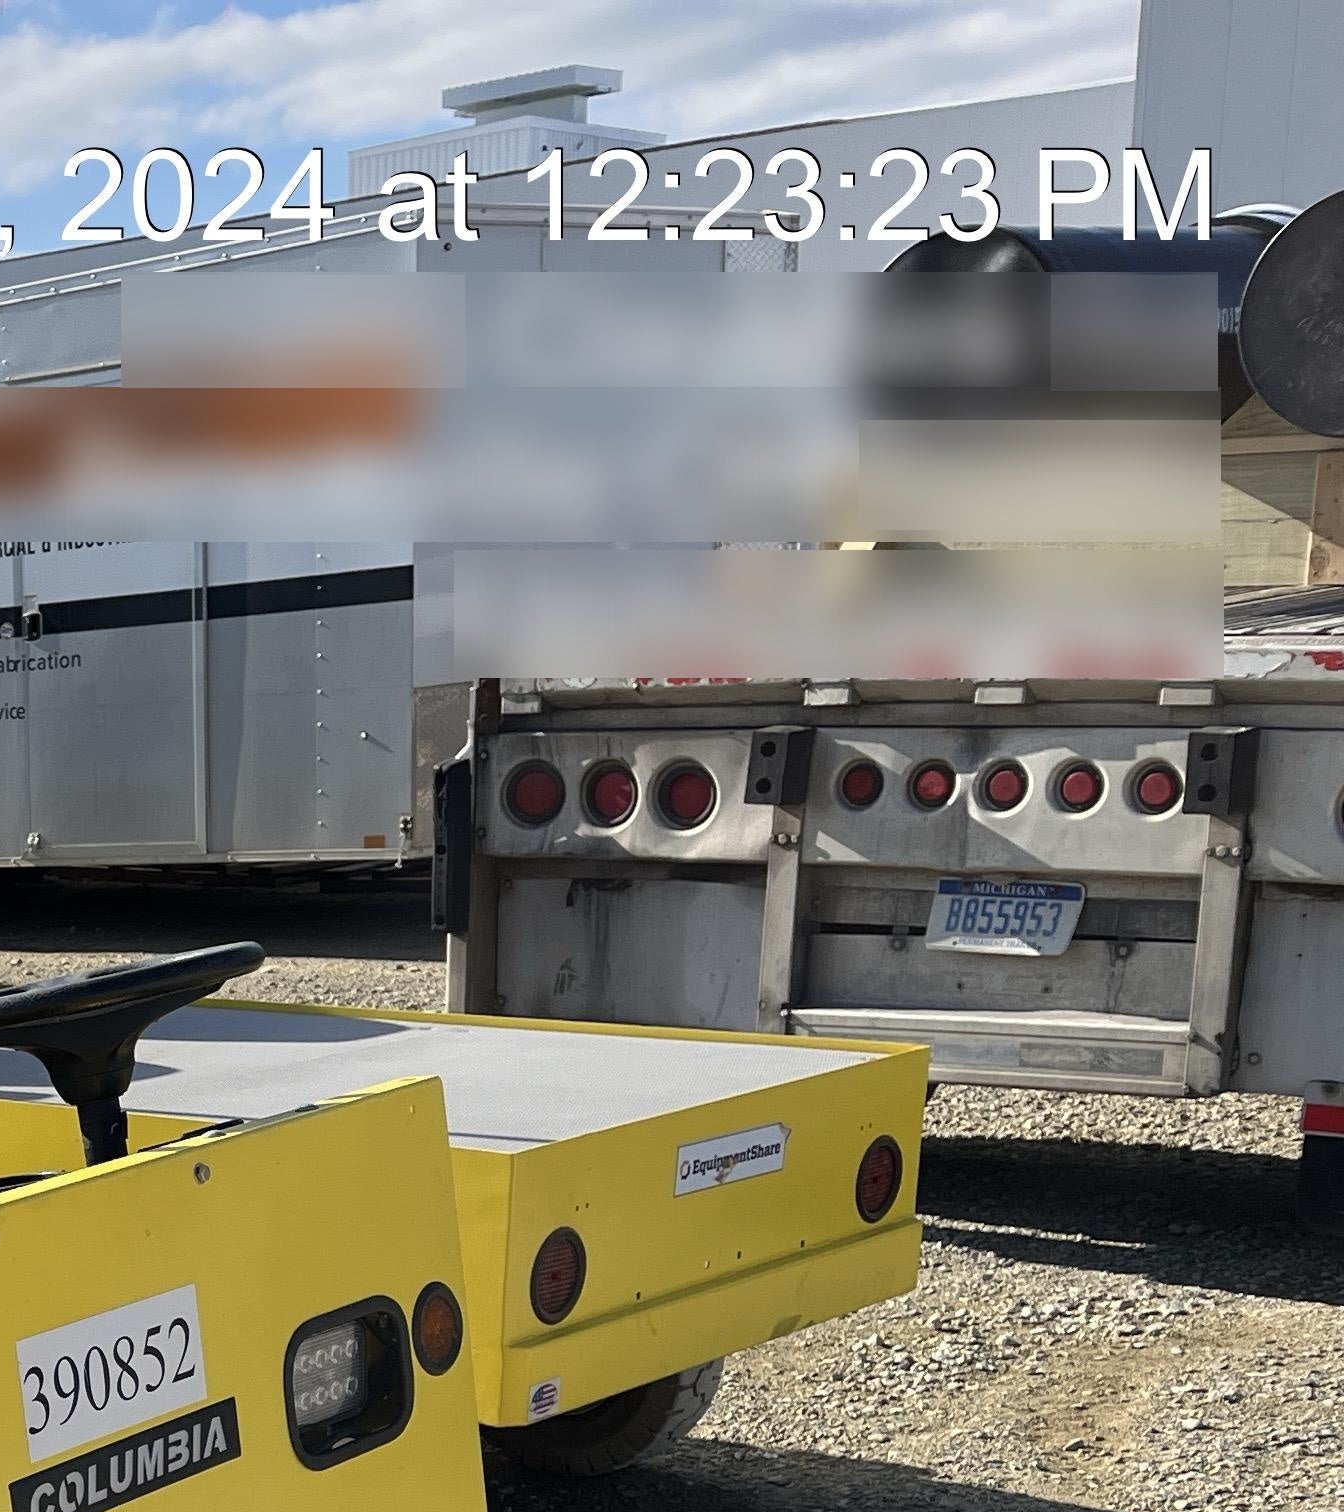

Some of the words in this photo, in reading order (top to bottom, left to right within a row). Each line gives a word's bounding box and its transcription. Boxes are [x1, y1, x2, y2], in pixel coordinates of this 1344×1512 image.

[972, 881, 1048, 898] MICHIGAN
[945, 897, 1063, 938] B855953
[691, 1142, 781, 1176] EquipmentShare
[23, 1317, 196, 1435] 390852
